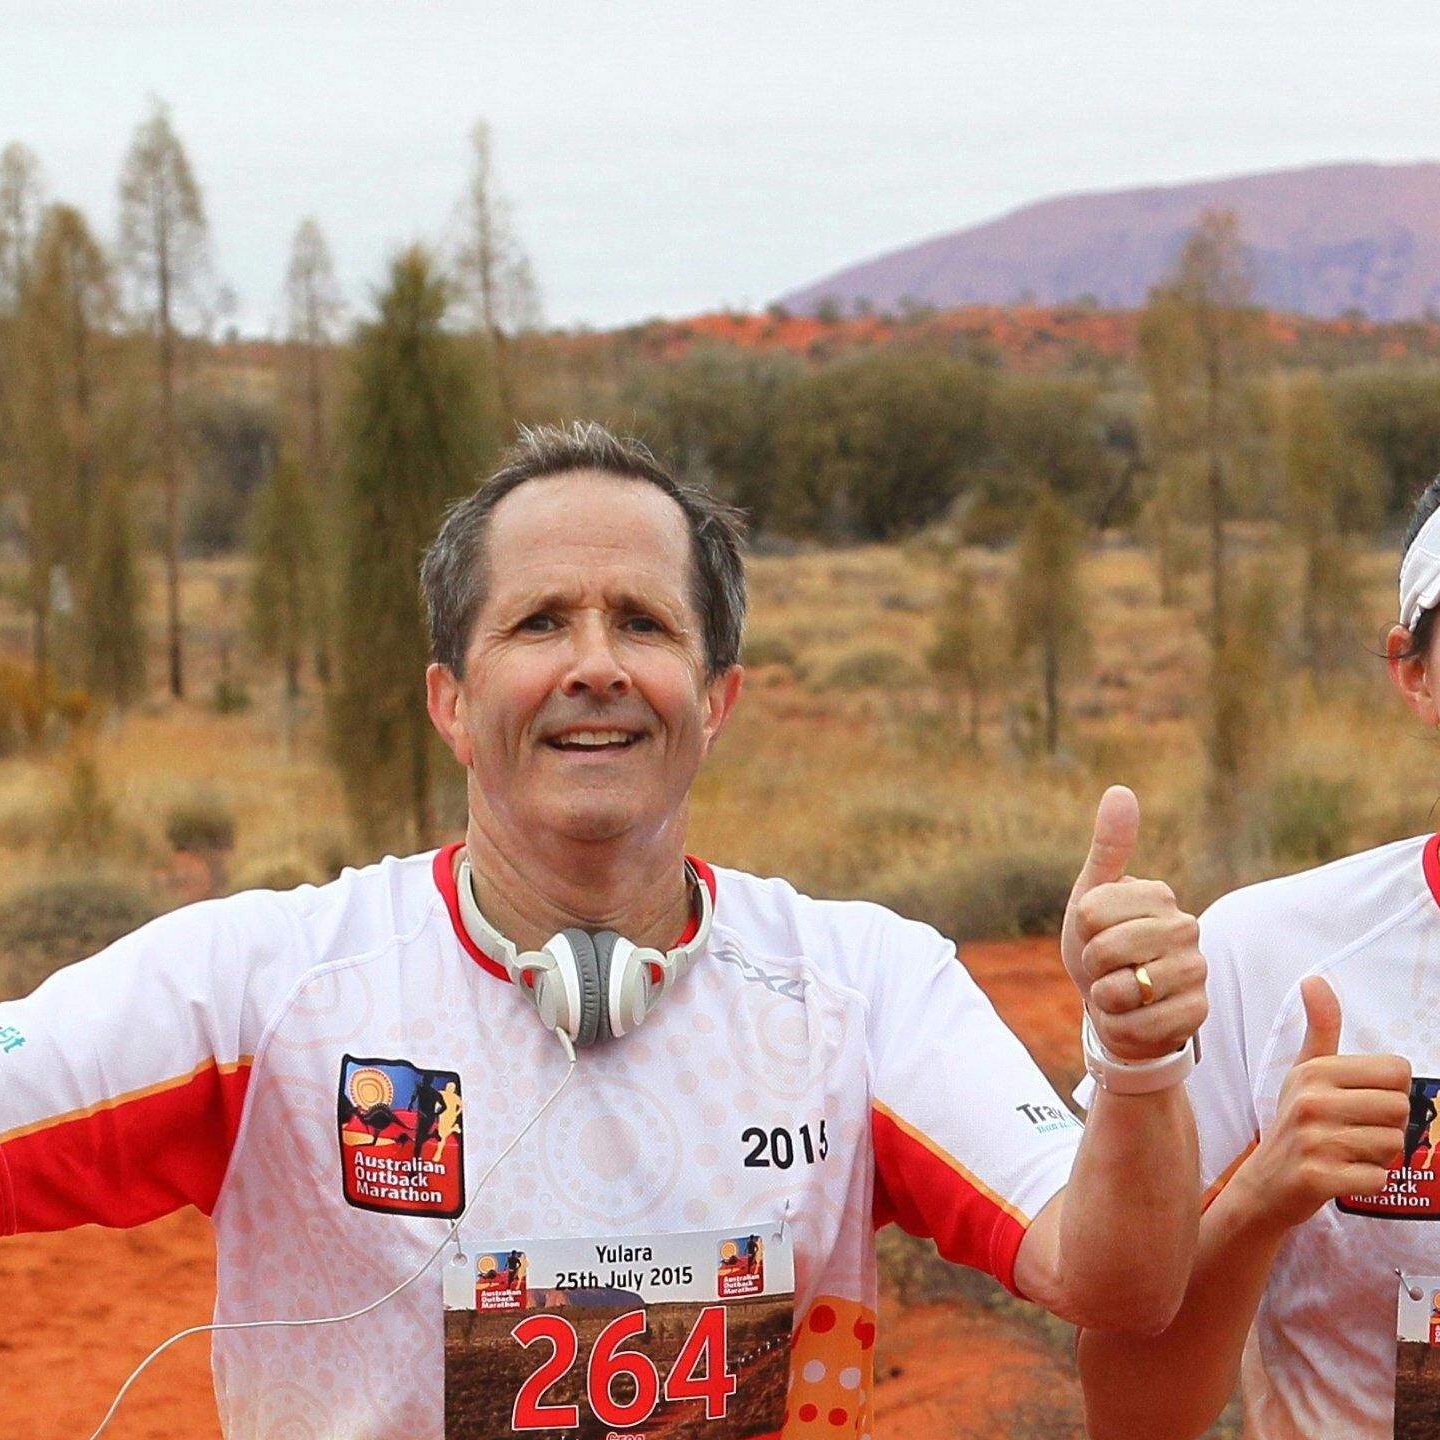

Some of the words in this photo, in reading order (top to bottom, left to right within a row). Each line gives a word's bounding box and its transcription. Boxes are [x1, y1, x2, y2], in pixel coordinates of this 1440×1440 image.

[741, 1119, 828, 1170] 2015
[354, 1151, 446, 1175] Australian
[1385, 1166, 1435, 1180] ralian
[355, 1166, 428, 1187] Outback
[356, 1180, 443, 1203] Marathon
[595, 1244, 652, 1265] Yulara
[556, 1271, 599, 1291] 25th
[605, 1269, 644, 1291] July
[650, 1265, 693, 1286] 2015
[723, 1273, 760, 1283] Australian
[723, 1281, 753, 1290] Outback
[481, 1289, 522, 1298] Australian
[723, 1286, 759, 1295] Marathon
[481, 1301, 521, 1309] Marathon
[511, 1305, 738, 1432] 264
